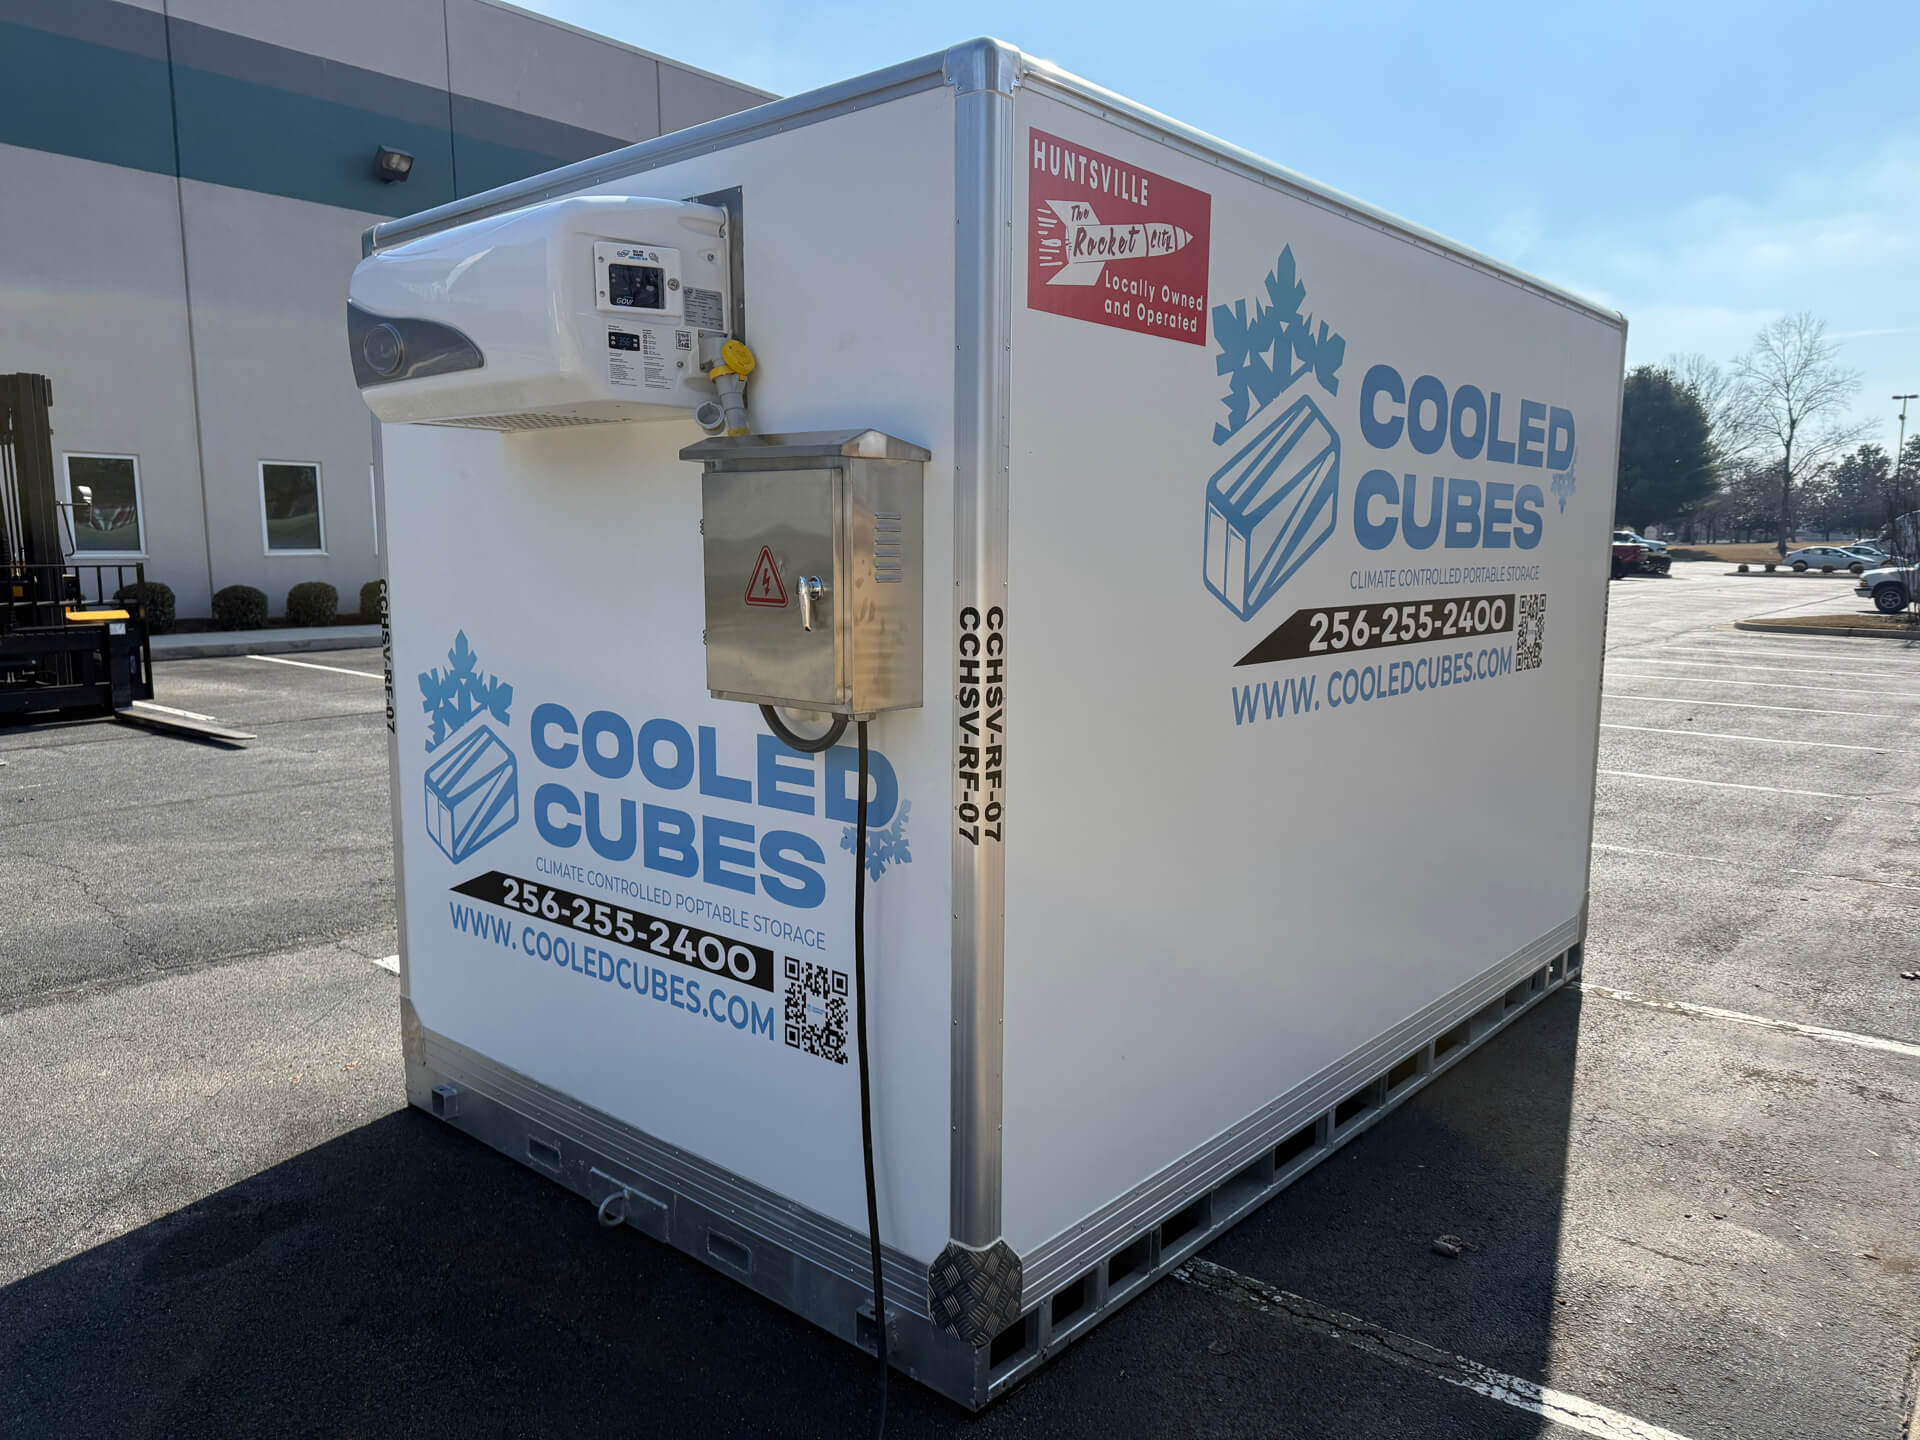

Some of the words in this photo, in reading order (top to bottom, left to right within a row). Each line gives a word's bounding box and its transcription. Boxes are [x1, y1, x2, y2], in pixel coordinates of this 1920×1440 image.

[1034, 139, 1149, 206] HUNTSVILLE
[1071, 205, 1089, 222] The
[1073, 226, 1140, 257] Rocket
[1150, 230, 1173, 250] City
[1105, 270, 1155, 301] Locally
[1161, 285, 1203, 311] Owned
[1105, 299, 1130, 317] and
[1137, 304, 1197, 333] Operated
[1359, 364, 1575, 471] COOLED
[1353, 469, 1545, 550] CUBES
[1350, 569, 1397, 590] CLIMATE
[1399, 567, 1461, 587] CONTROLLED
[1463, 567, 1505, 584] PORTABLE
[1506, 565, 1540, 582] STORAGE
[1308, 599, 1507, 652] 256-255-2400
[958, 606, 981, 846] CCHSV-RF-07
[984, 606, 1004, 842] CCHSV-RF-07
[1232, 675, 1320, 726] WWW.
[1327, 646, 1512, 706] COOLEDCUBES.COM
[530, 702, 899, 828] COOLED
[534, 782, 826, 909] CUBES
[502, 877, 758, 982] 256-255-2400
[535, 856, 585, 884] CLIMATE
[587, 870, 672, 908] CONTROLLED
[753, 914, 826, 951] STORAGE
[449, 902, 517, 951] WWW.
[522, 926, 775, 1041] COOLEDCUBES.COM
